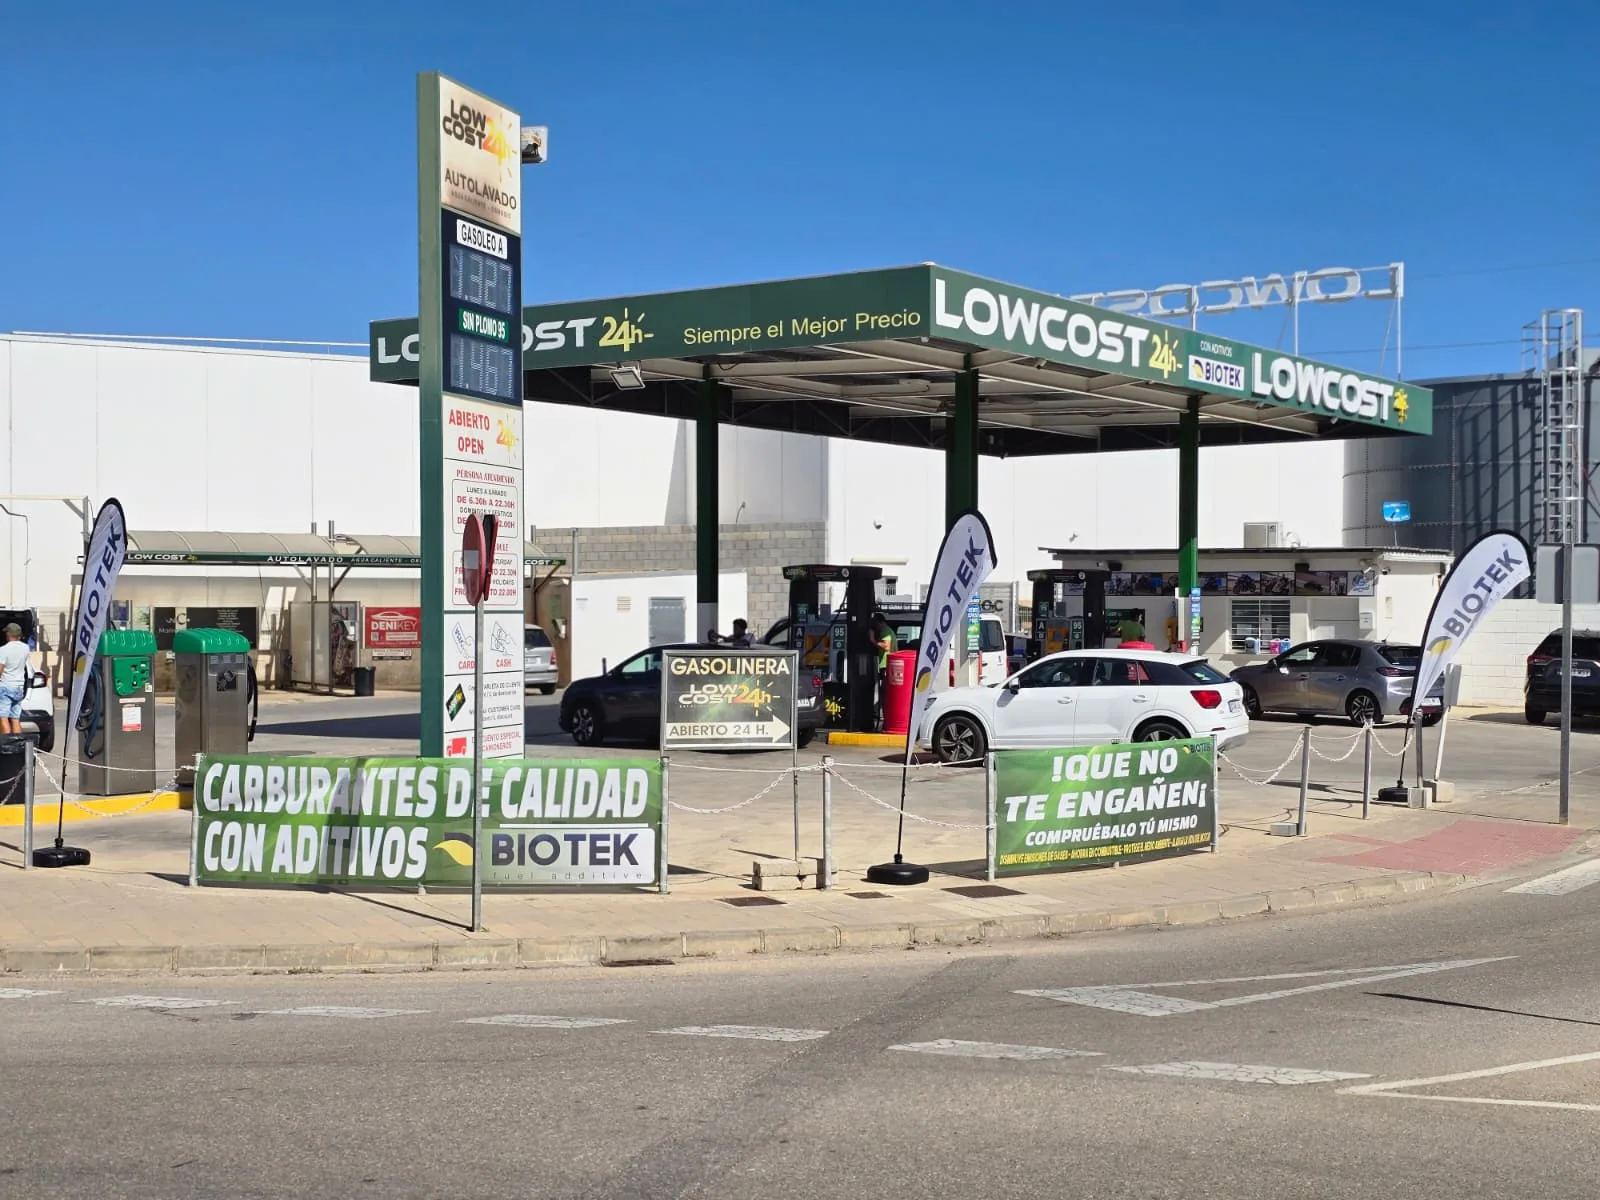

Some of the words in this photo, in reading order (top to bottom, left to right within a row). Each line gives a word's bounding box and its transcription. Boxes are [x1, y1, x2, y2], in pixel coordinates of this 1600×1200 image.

[450, 98, 486, 131] LOW
[443, 115, 486, 150] COST
[444, 167, 517, 210] AUTOLAVADO
[461, 223, 496, 251] GASOLEO
[497, 238, 504, 255] A
[463, 311, 474, 332] SIN
[475, 313, 497, 338] PLOMO
[497, 321, 506, 340] 95
[598, 311, 647, 353] 24h
[683, 325, 761, 345] Siempre
[767, 320, 783, 338] el
[791, 316, 847, 339] Mejor
[855, 308, 921, 331] Precio
[935, 278, 1150, 368] LOWCOST
[1148, 330, 1178, 379] 24h
[1200, 340, 1211, 352] CON
[1211, 343, 1233, 358] ADITIVOS
[1205, 361, 1241, 388] BIOTEK
[1251, 351, 1394, 422] LOWCOST
[449, 409, 490, 431] ABIERTO
[458, 436, 485, 455] OPEN
[456, 495, 467, 504] DE
[154, 553, 186, 561] COST
[79, 523, 122, 652] BIOTEK
[925, 536, 984, 667] BIOTEK
[1442, 549, 1523, 638] BIOTEK
[371, 620, 417, 631] DENIKEY
[834, 627, 845, 637] 95
[1072, 621, 1082, 630] 95
[496, 659, 512, 668] CASH
[670, 657, 790, 676] GASOLINERA
[678, 694, 735, 705] COST
[732, 682, 772, 709] 24h
[690, 683, 738, 694] LOW
[824, 697, 842, 717] 24h
[669, 724, 728, 737] ABIERTO
[733, 725, 750, 736] 24
[756, 725, 769, 736] H.
[1051, 750, 1131, 783] !QUE
[1138, 747, 1179, 776] NO
[203, 762, 438, 818] CARBURANTES
[445, 766, 493, 818] DE
[500, 766, 649, 819] CALIDAD
[1004, 794, 1048, 822] TE
[1057, 777, 1207, 820] ENGAÑEN¡
[1140, 816, 1155, 835] TÚ
[1158, 814, 1198, 834] MISMO
[203, 821, 266, 873] CON
[271, 824, 429, 880] ADITIVOS
[491, 833, 640, 867] BIOTEK
[493, 871, 534, 880] fuel
[551, 871, 642, 880] additive
